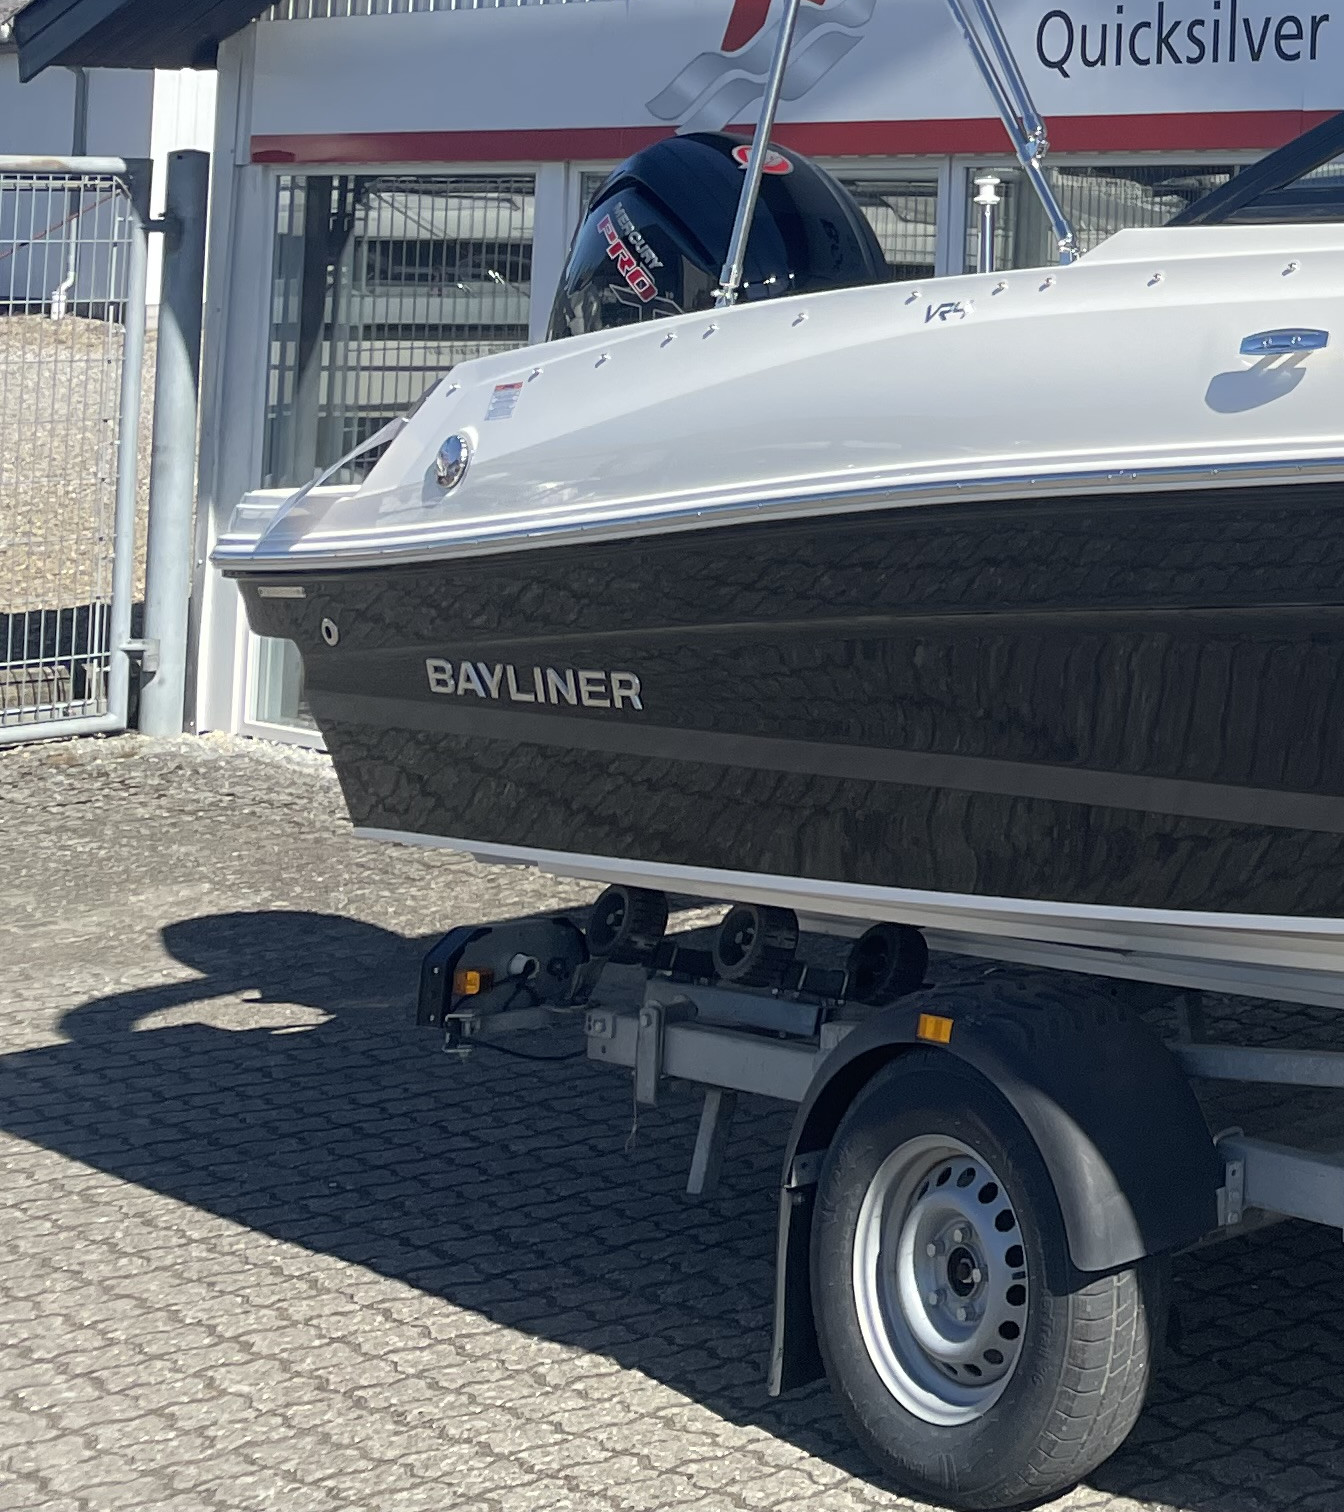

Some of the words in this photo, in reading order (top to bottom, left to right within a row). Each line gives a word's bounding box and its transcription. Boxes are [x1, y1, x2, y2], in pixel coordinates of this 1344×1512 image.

[597, 213, 659, 303] PRO
[614, 201, 664, 269] MERCURY
[425, 657, 644, 711] BAYLINER
